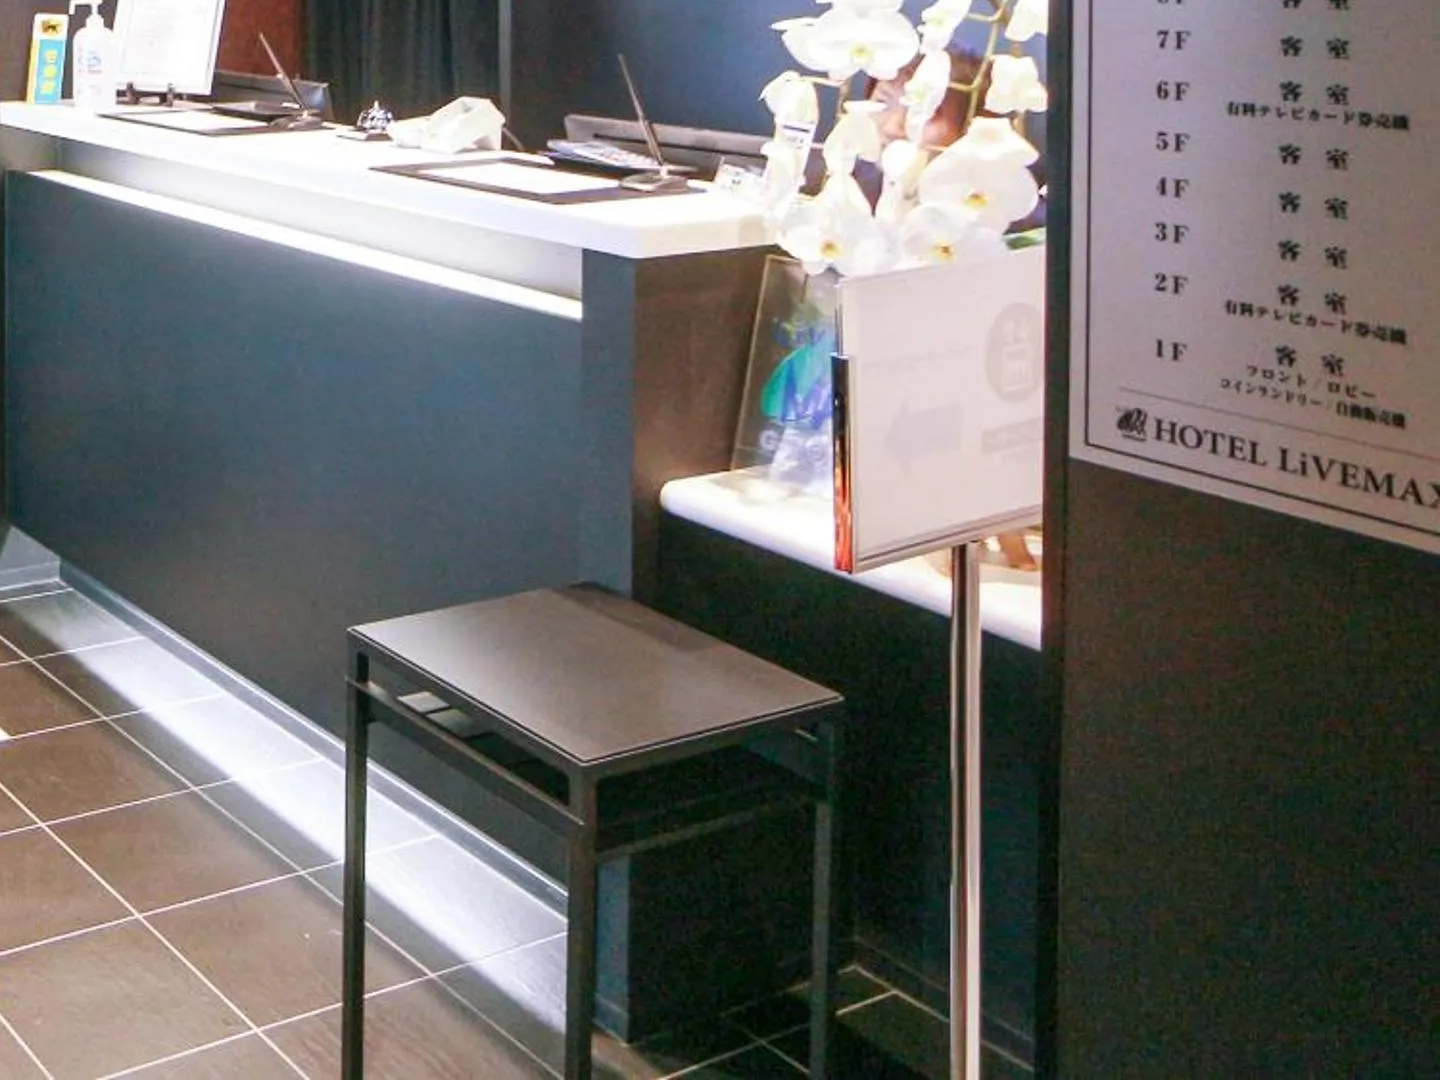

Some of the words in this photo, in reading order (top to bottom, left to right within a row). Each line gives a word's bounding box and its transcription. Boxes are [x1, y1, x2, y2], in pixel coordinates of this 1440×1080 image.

[1156, 30, 1191, 50] 7F
[1156, 81, 1190, 101] 6F
[1156, 132, 1190, 152] 5F
[1156, 177, 1189, 198] 4F
[1155, 222, 1189, 244] 3F
[1154, 273, 1188, 295] 2F
[1155, 339, 1187, 361] 1F
[1154, 415, 1267, 466] HOTEL
